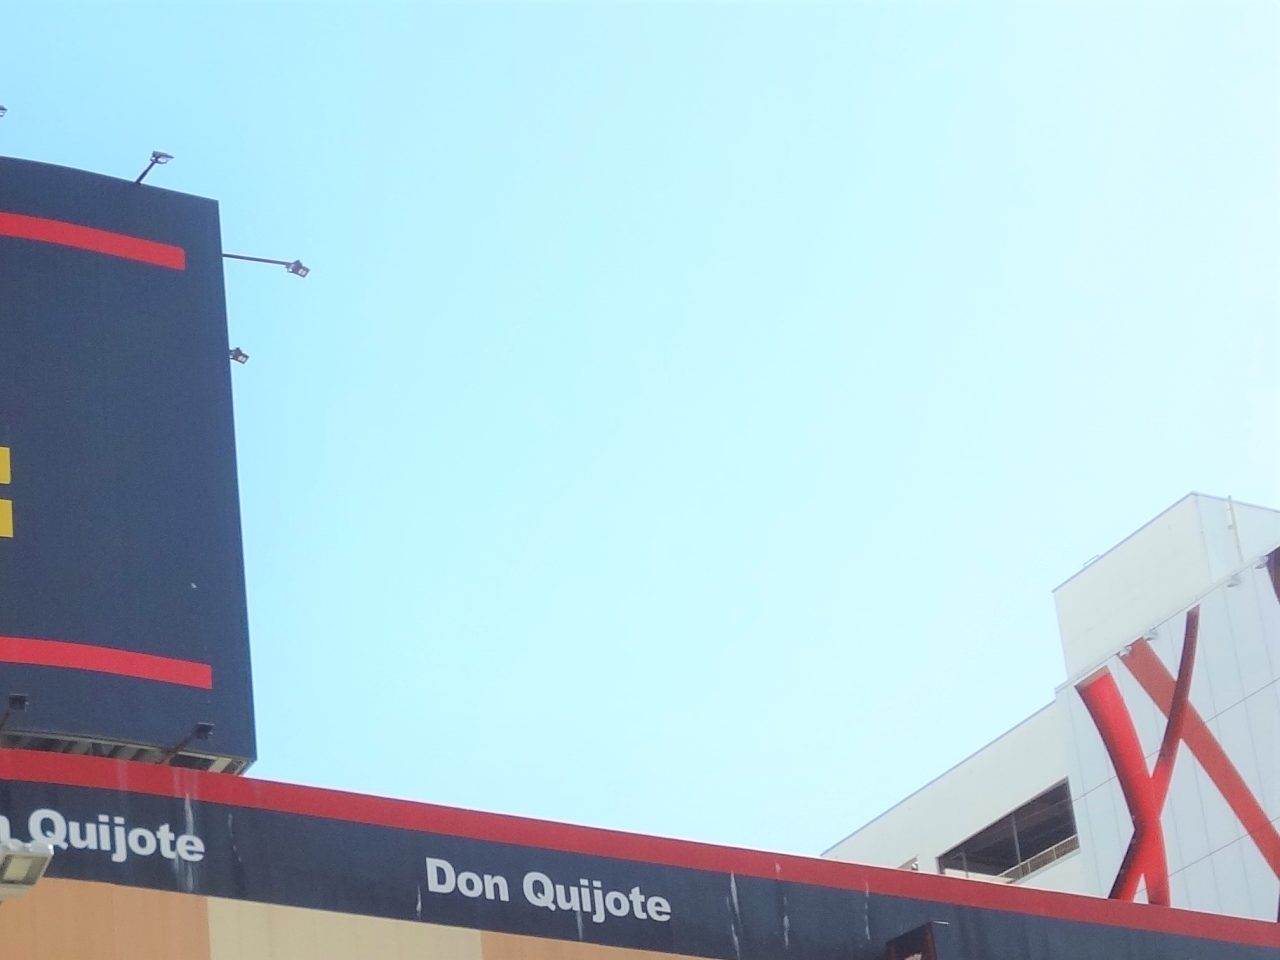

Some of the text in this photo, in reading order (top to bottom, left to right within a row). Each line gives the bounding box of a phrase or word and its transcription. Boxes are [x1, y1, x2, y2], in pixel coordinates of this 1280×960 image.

[28, 808, 205, 862] Quijote
[426, 857, 671, 923] Don Quijote
